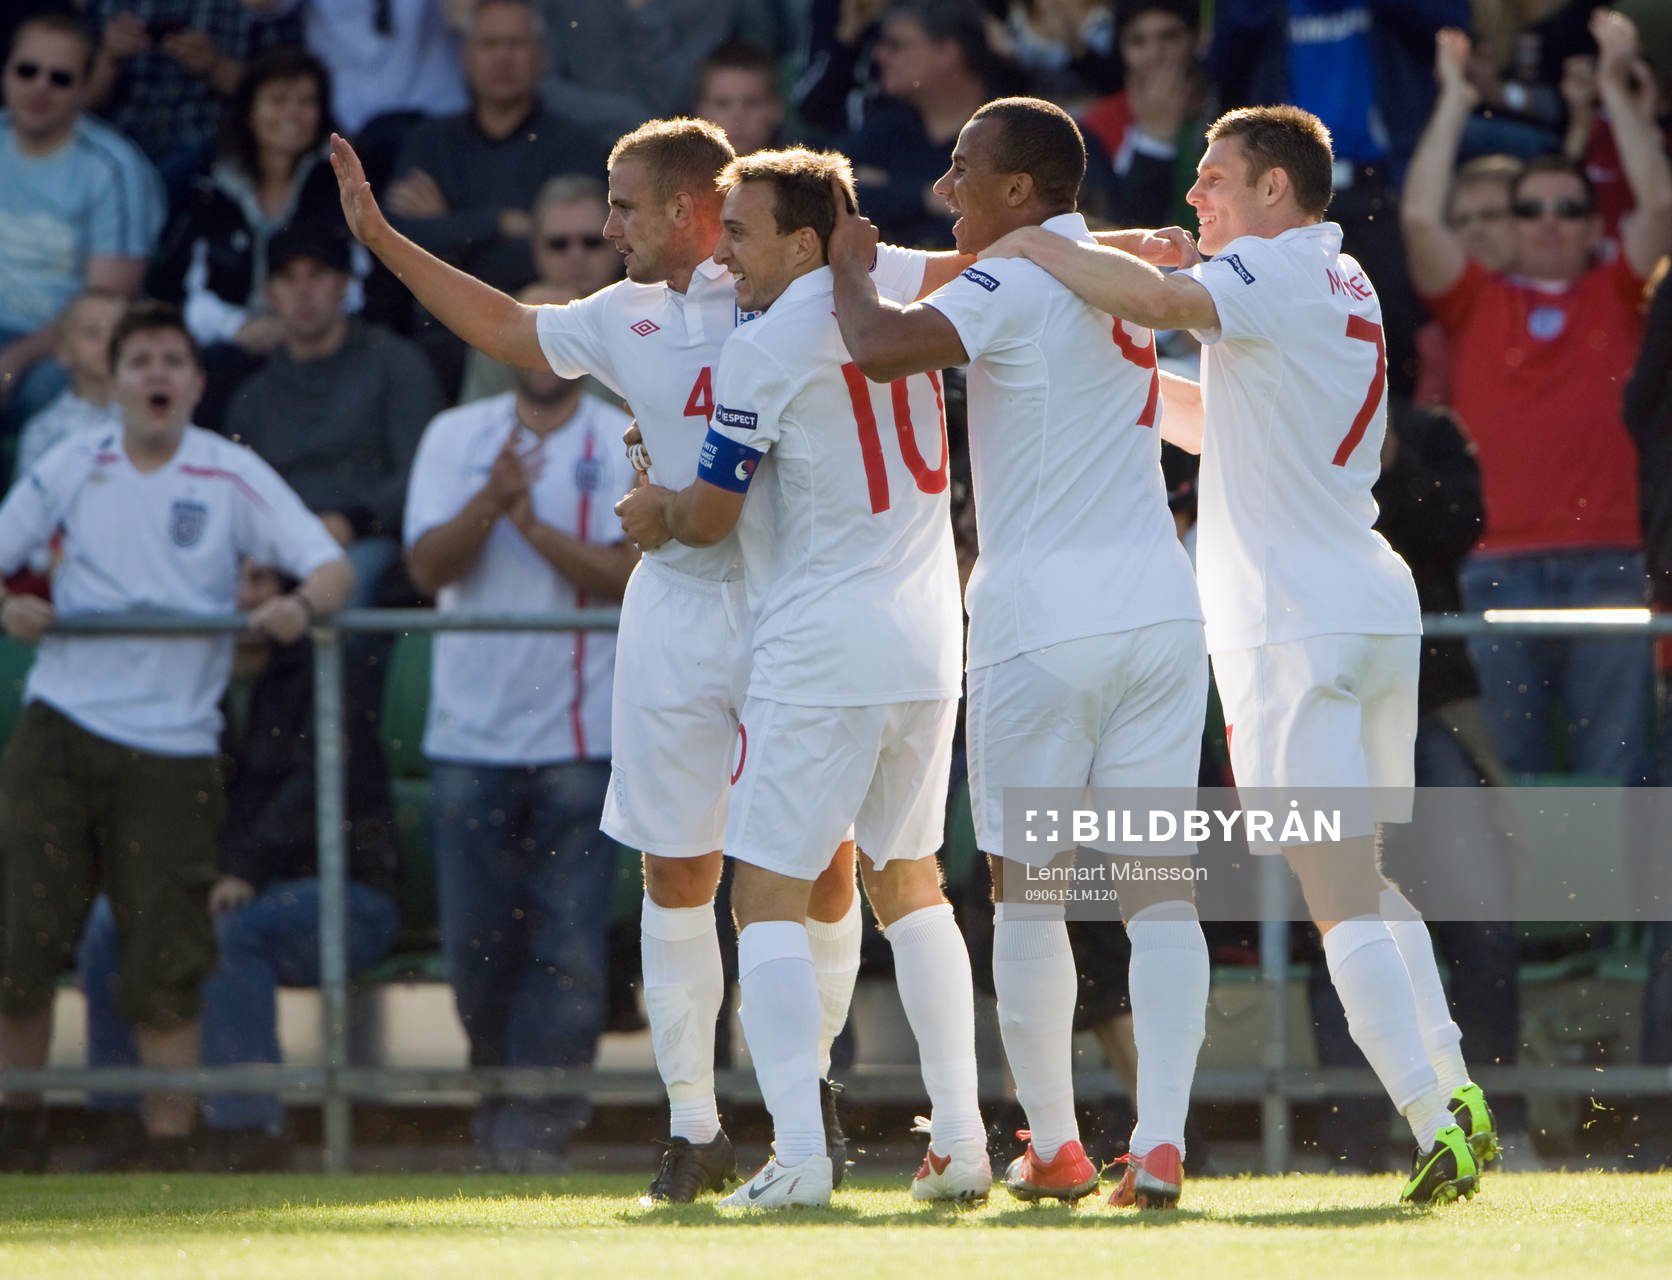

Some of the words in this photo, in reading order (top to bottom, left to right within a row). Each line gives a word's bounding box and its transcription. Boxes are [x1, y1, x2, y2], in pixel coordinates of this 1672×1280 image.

[965, 269, 996, 288] ESPECT
[683, 366, 715, 425] 4
[1112, 316, 1160, 428] 9
[1332, 314, 1388, 467] 7
[721, 411, 756, 426] ESPECT
[841, 361, 949, 514] 10
